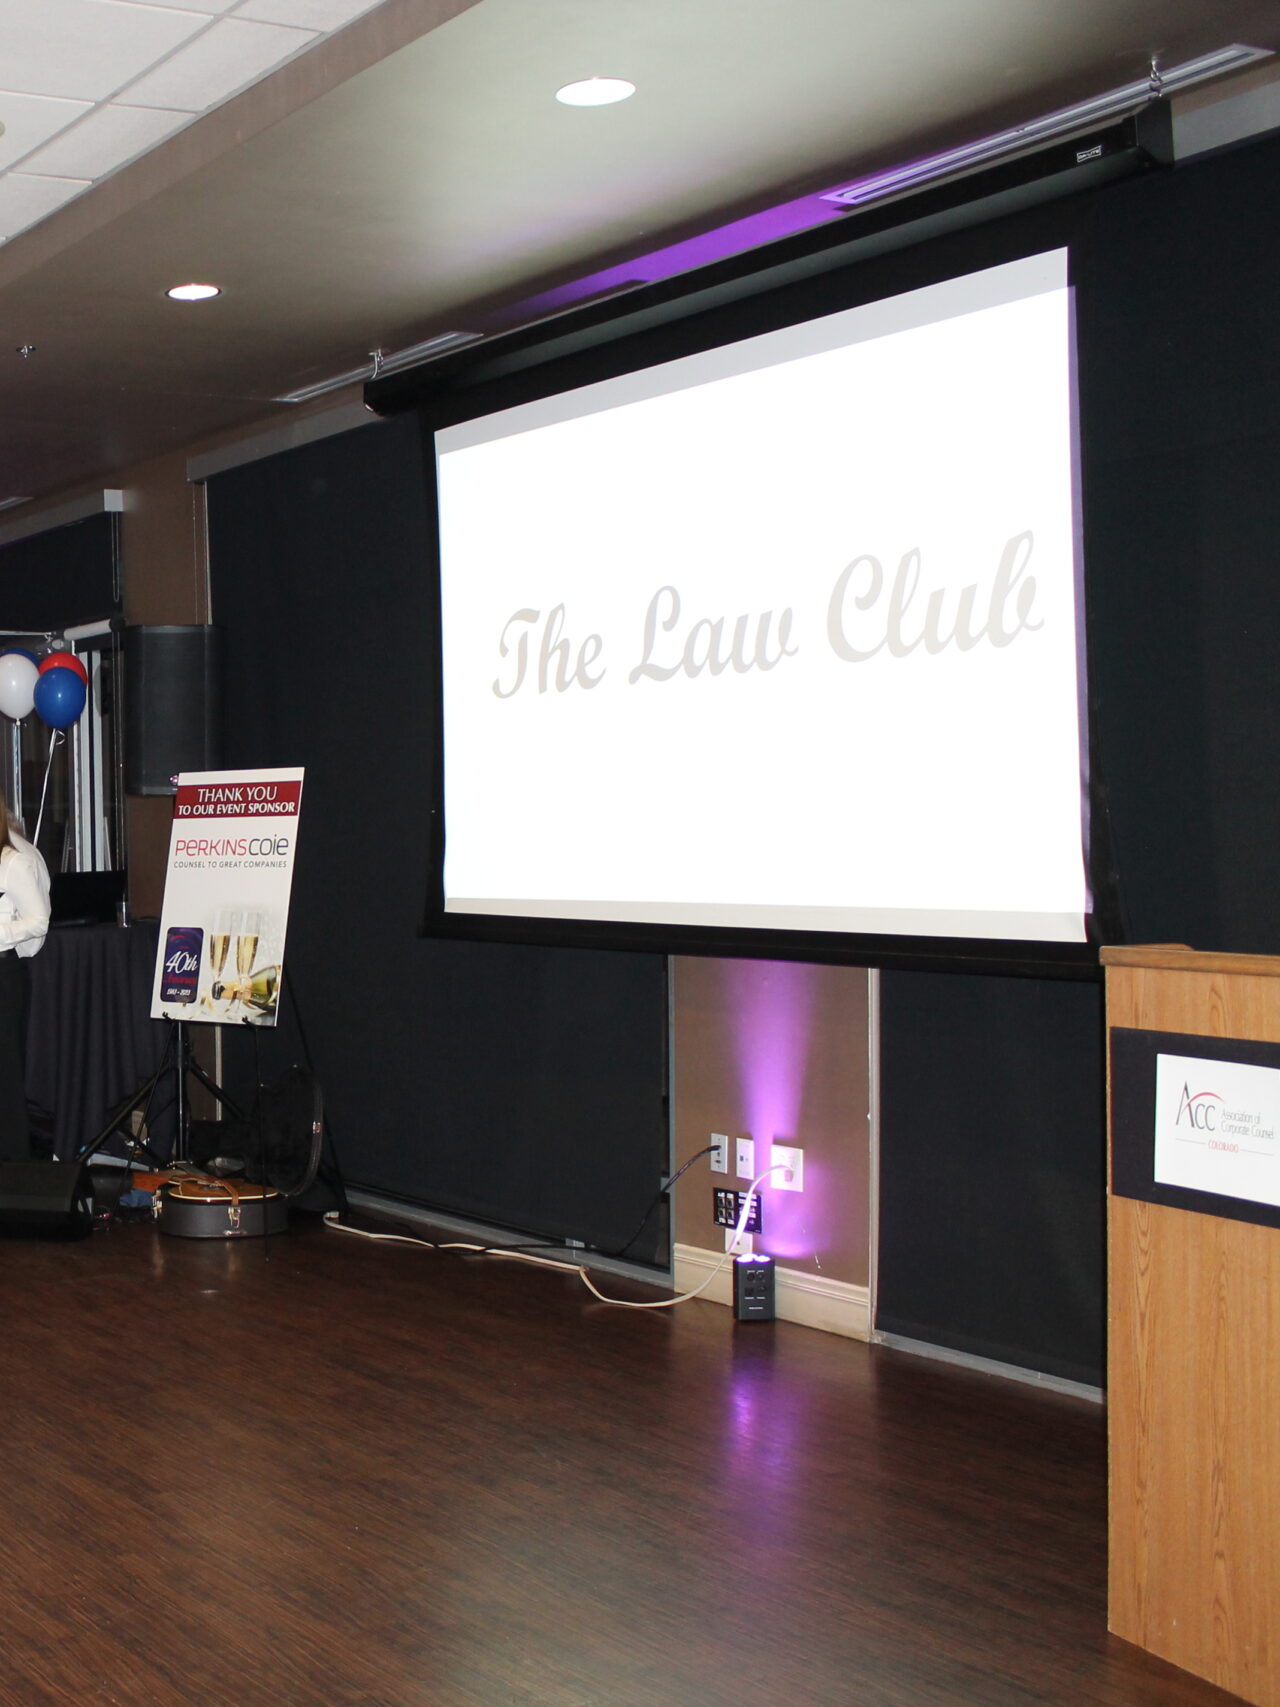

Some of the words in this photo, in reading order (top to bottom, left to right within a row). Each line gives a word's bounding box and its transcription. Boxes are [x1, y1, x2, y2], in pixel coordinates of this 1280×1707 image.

[492, 602, 606, 699] The
[628, 585, 800, 686] Law
[826, 529, 1045, 663] Club
[198, 788, 244, 802] THANK
[246, 786, 277, 801] YOU
[179, 805, 191, 815] TO
[193, 805, 214, 815] OUR
[216, 803, 246, 814] EVENT
[248, 802, 295, 814] SPONSOR
[173, 861, 206, 869] COUNSEL
[166, 951, 198, 973] 40th
